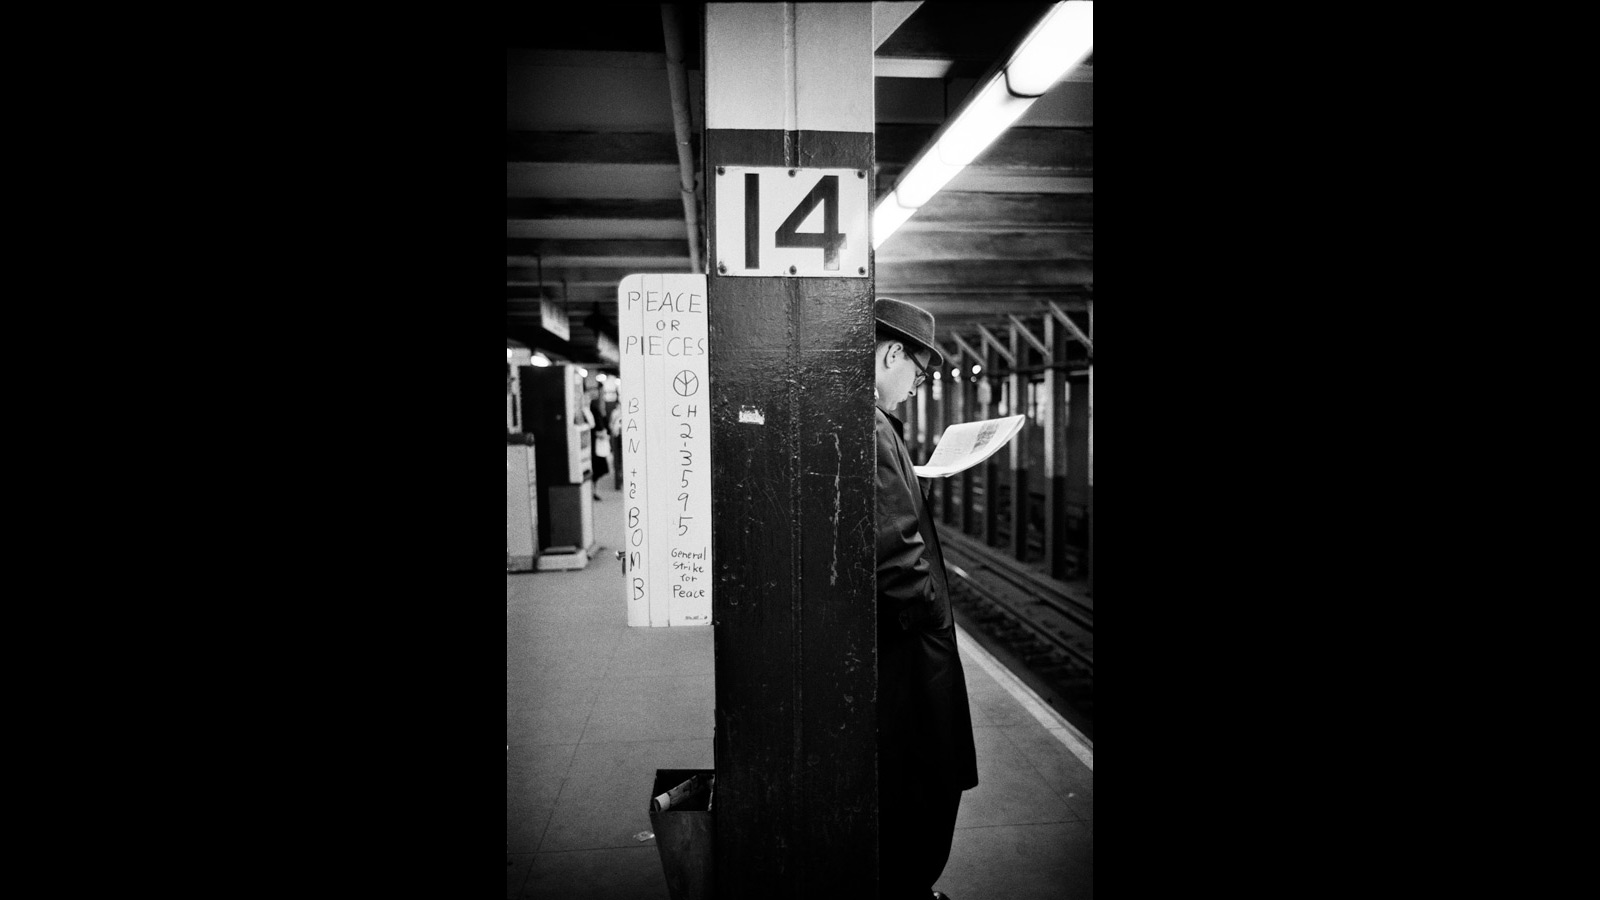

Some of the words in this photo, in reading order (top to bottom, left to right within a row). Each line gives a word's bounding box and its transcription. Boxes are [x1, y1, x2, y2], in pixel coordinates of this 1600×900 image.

[745, 173, 847, 270] 14
[628, 290, 702, 313] PEACE
[656, 319, 680, 331] OR
[626, 335, 704, 357] PIECES
[672, 404, 697, 418] CH
[626, 397, 640, 454] BAN
[628, 507, 644, 600] BOMB
[671, 546, 707, 560] General
[681, 573, 698, 582] for
[673, 584, 705, 598] Peace
